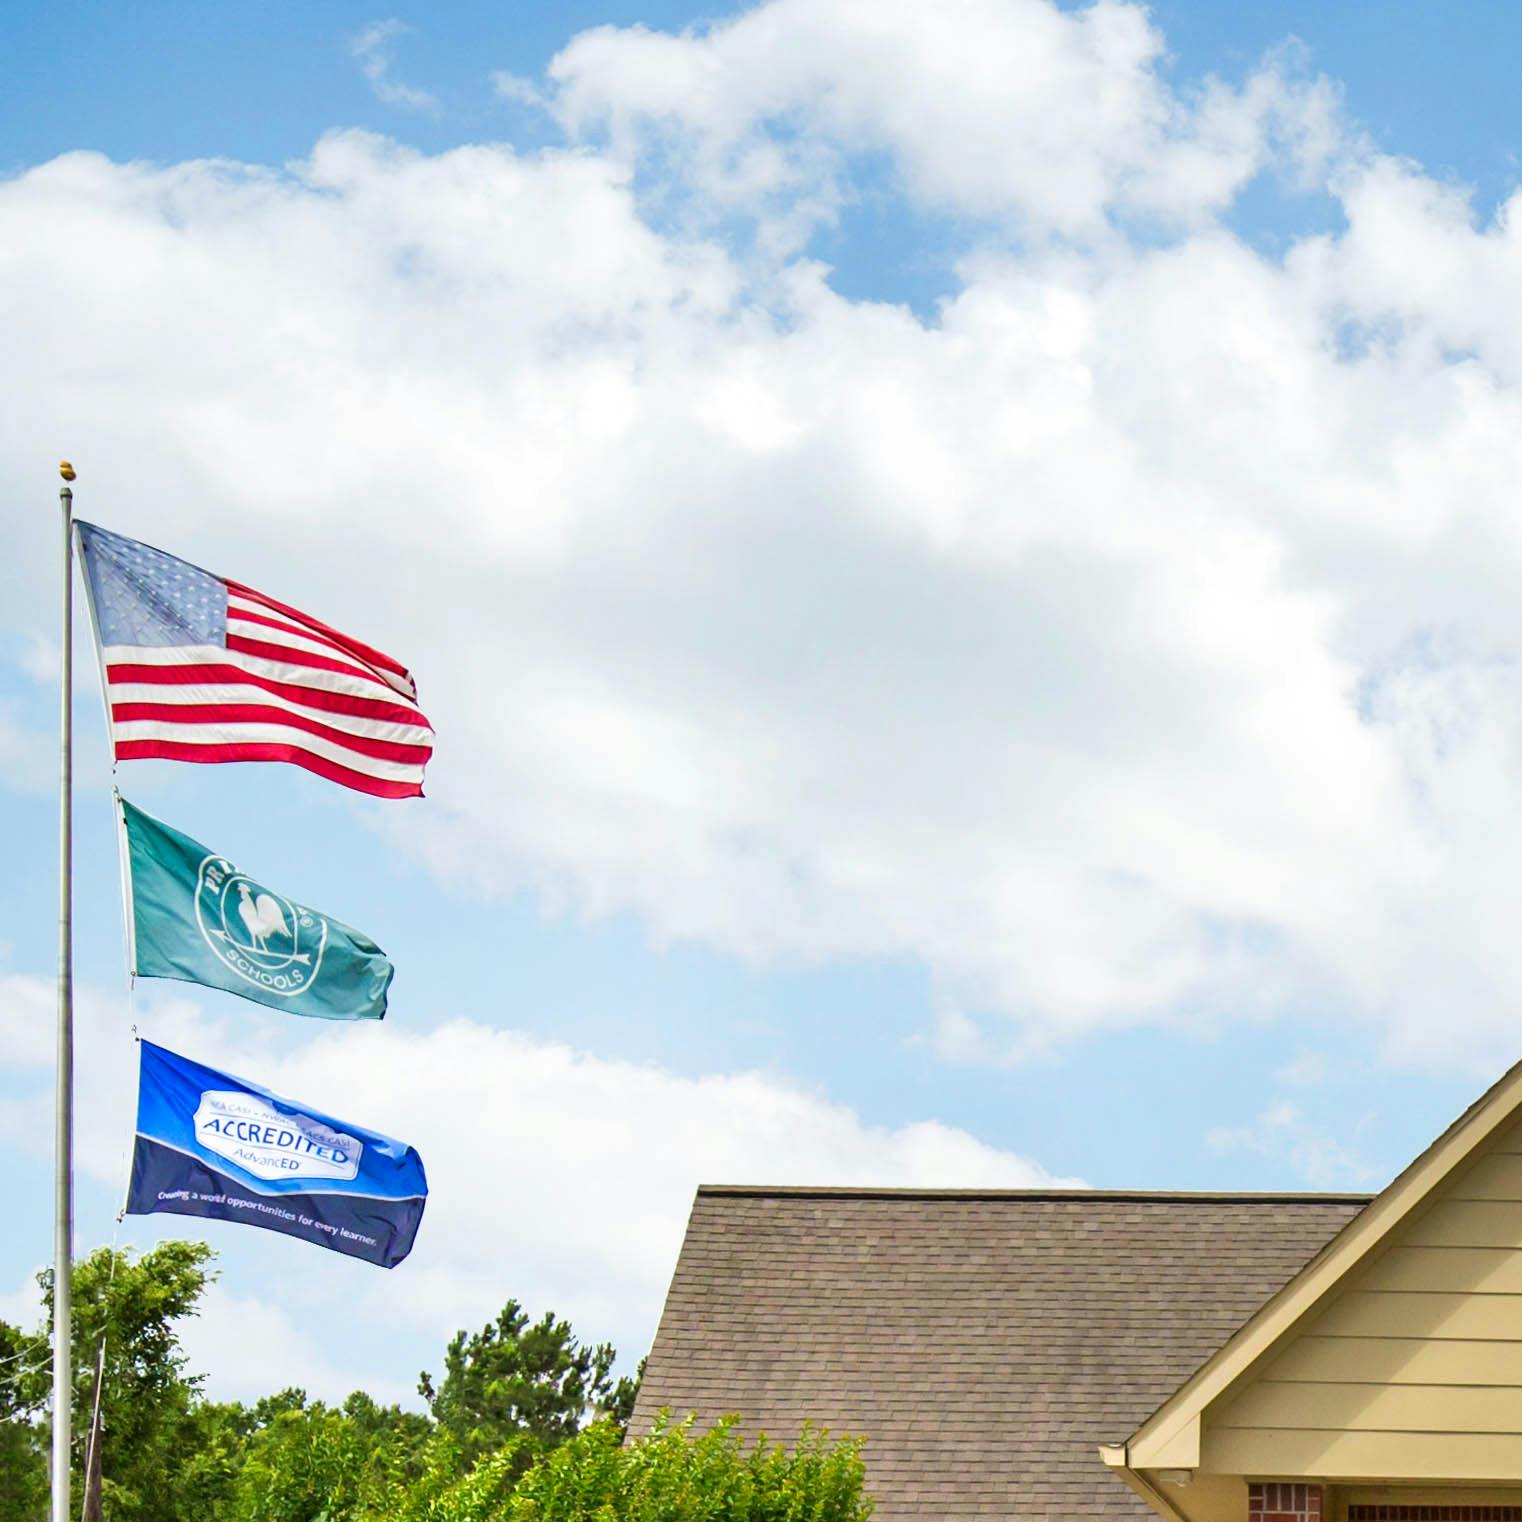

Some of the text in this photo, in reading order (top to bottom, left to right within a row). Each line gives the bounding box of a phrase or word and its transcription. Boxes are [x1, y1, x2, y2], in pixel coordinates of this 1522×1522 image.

[226, 949, 304, 989] SCHOOLS
[203, 1118, 349, 1164] ACCREDITED
[234, 1148, 300, 1171] AdvancED
[227, 1197, 296, 1221] opportunities
[298, 1214, 313, 1226] for
[340, 1227, 377, 1246] learner.
